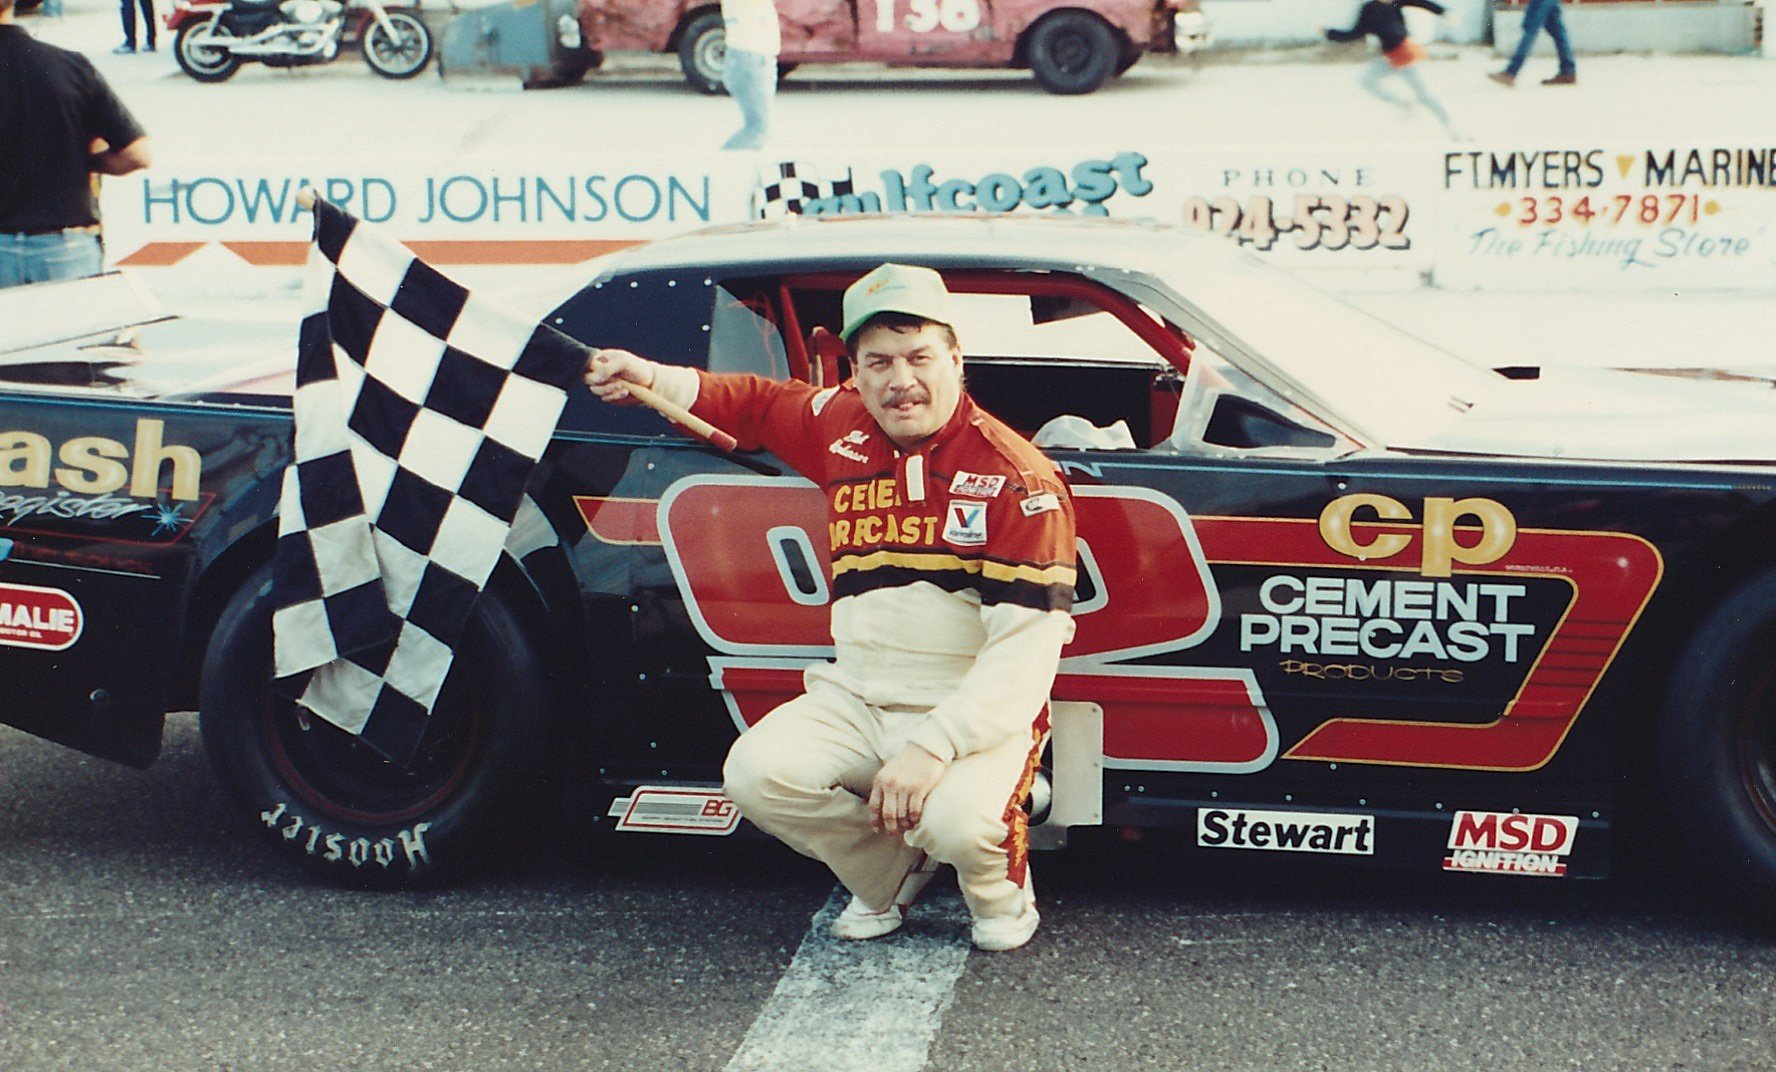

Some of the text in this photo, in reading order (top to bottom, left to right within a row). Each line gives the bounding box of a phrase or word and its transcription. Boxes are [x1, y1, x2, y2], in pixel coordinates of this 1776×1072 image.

[1223, 168, 1373, 187] PHONE
[143, 174, 710, 225] HOWARD JOHNSON
[1318, 493, 1516, 577] cp
[1259, 575, 1527, 623] CEMENT
[1240, 614, 1536, 662] PRECAST
[1279, 659, 1464, 683] PRODUCTS
[701, 799, 733, 817] BG
[1200, 810, 1371, 852] Stewart
[1454, 811, 1568, 852] MSD
[1450, 849, 1559, 873] IGNITION
